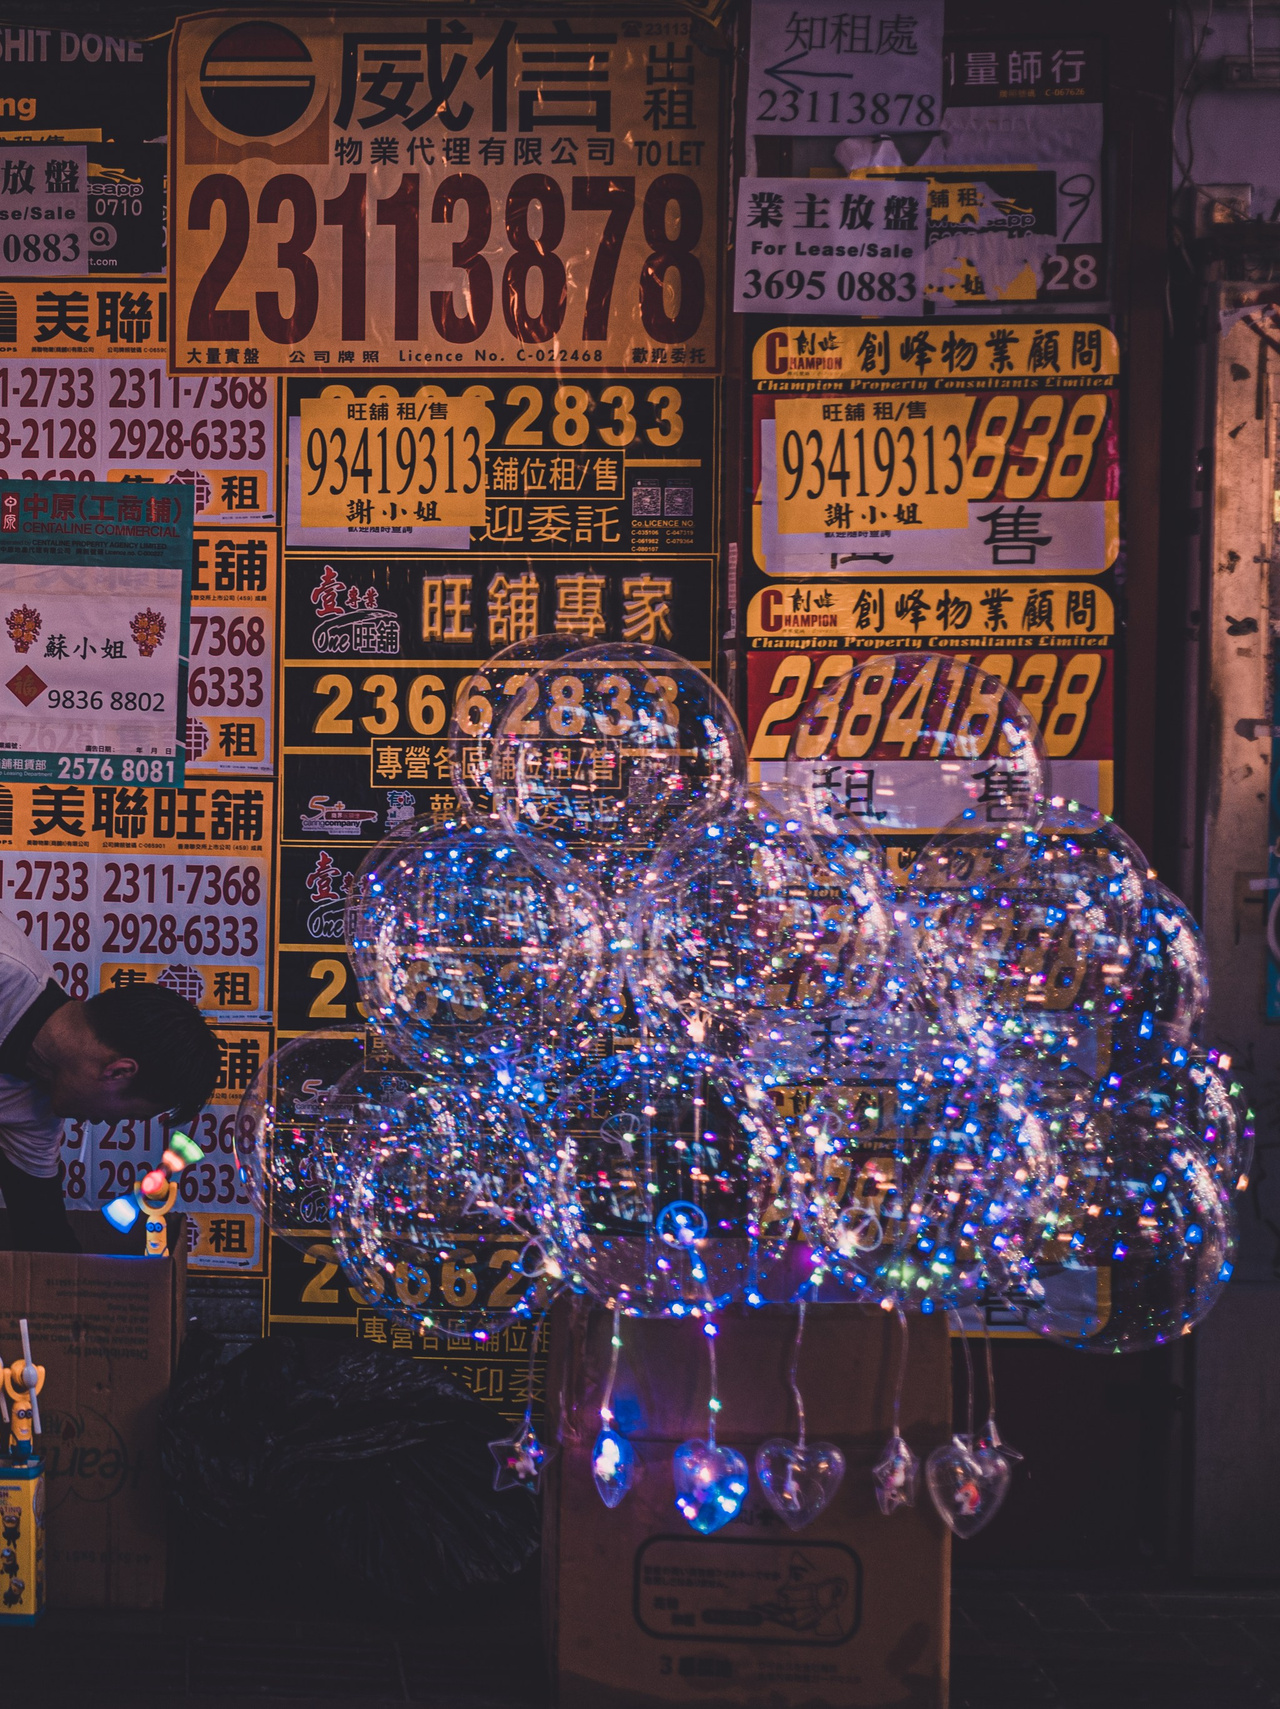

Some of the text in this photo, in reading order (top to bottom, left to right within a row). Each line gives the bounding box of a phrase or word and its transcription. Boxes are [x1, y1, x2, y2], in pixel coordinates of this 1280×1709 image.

[785, 11, 918, 57] 知租處
[333, 18, 618, 134] 威信
[756, 89, 936, 127] 23113878
[334, 136, 615, 167] 物業代理有限公司
[635, 140, 705, 167] TO LET
[746, 192, 919, 232] 業主放盤
[3, 233, 81, 263] 0883
[186, 172, 706, 345] 23113878
[750, 240, 913, 260] For Lease/Sale
[743, 268, 917, 302] 3695 0883
[289, 349, 380, 364] 公司牌照
[399, 349, 464, 363] Licence
[475, 350, 504, 362] No.
[517, 349, 603, 363] C-022468
[856, 329, 1102, 374] 創峰物業顧問
[756, 375, 1114, 392] Champion Property Consultants Limited
[347, 402, 390, 421] 旺舖
[108, 419, 266, 460] 2928-6333
[307, 425, 482, 496] 93419313
[783, 425, 963, 500] 93419313
[221, 476, 259, 510] 租
[346, 500, 442, 524] 謝小姐
[824, 503, 923, 528] 謝小姐
[23, 523, 181, 538] CENTALINE COMMERCIAL
[32, 539, 70, 547] CENTALINE
[976, 505, 1052, 566] 售
[421, 572, 675, 646] 旺舖專家
[760, 589, 838, 631] CHAMPION
[853, 588, 1096, 632] 創峰物業顧問
[44, 634, 127, 661] 蘇小姐
[752, 635, 1108, 649] Champion Property Consultants Limited
[48, 690, 165, 712] 9836 8802
[749, 653, 1103, 759] 23841838
[219, 723, 257, 757] 租
[58, 756, 113, 781] 2576
[122, 758, 174, 783] 8081
[813, 765, 1032, 822] 租 售
[30, 785, 264, 842] 美聯旺舖
[103, 862, 261, 906] 2311-7368
[102, 913, 258, 957] 2928-6333
[213, 972, 251, 1005] 租
[210, 1219, 247, 1253] 租
